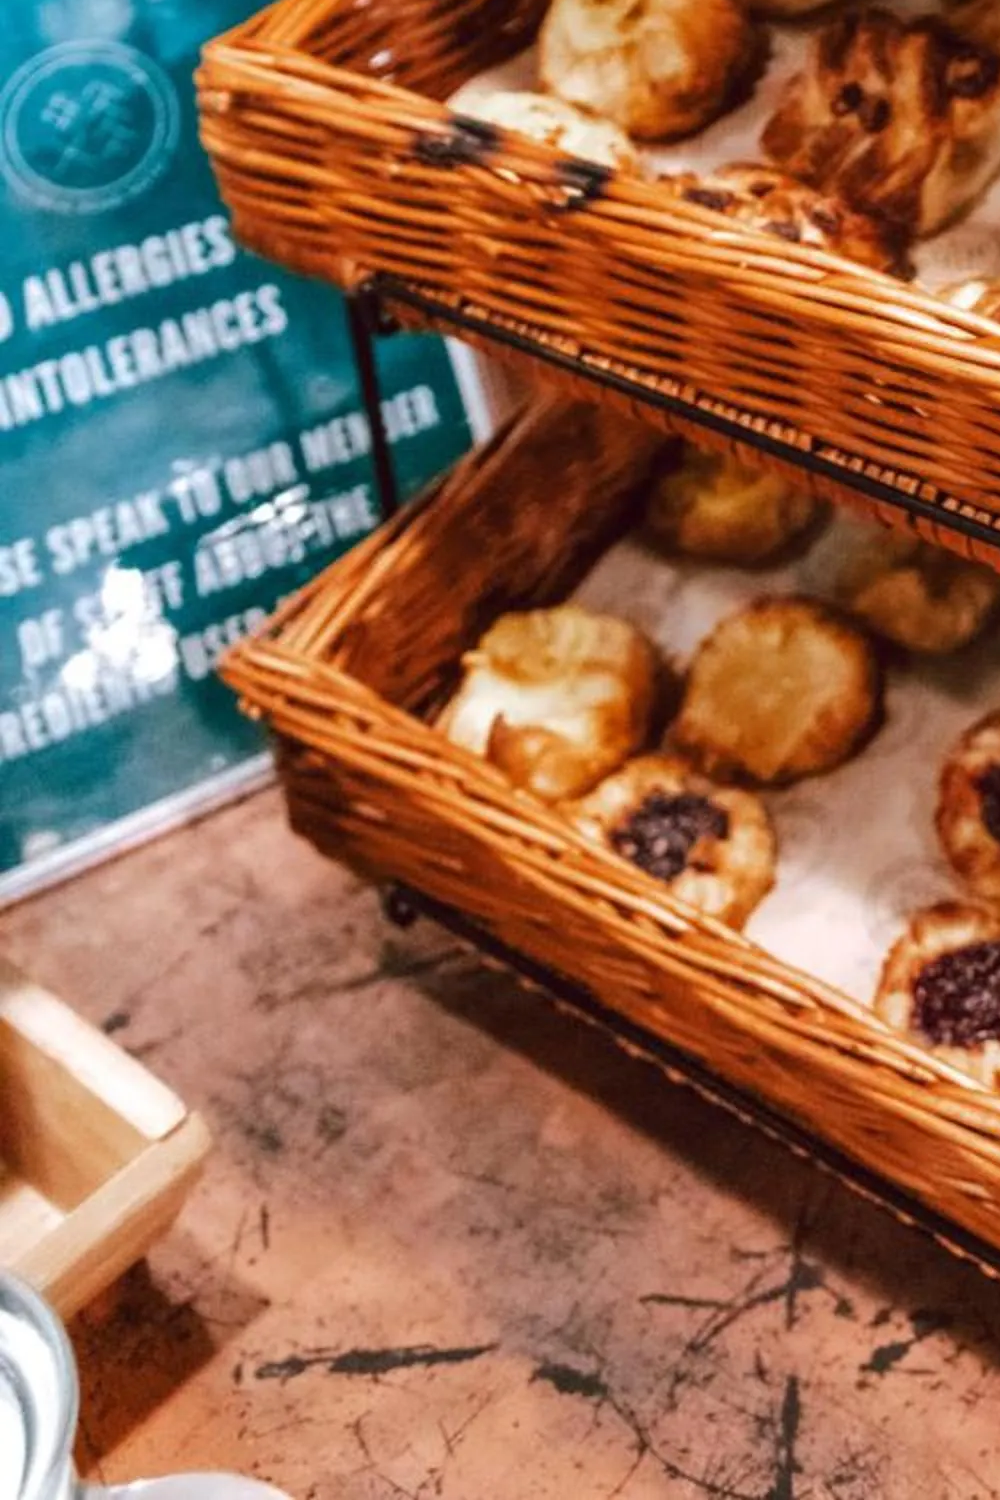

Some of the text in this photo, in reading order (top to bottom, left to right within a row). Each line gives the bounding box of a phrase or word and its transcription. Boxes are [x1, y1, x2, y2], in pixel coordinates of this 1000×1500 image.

[23, 215, 235, 331] ALLERGIES
[46, 490, 170, 575] SPEAK
[224, 441, 298, 504] OUR
